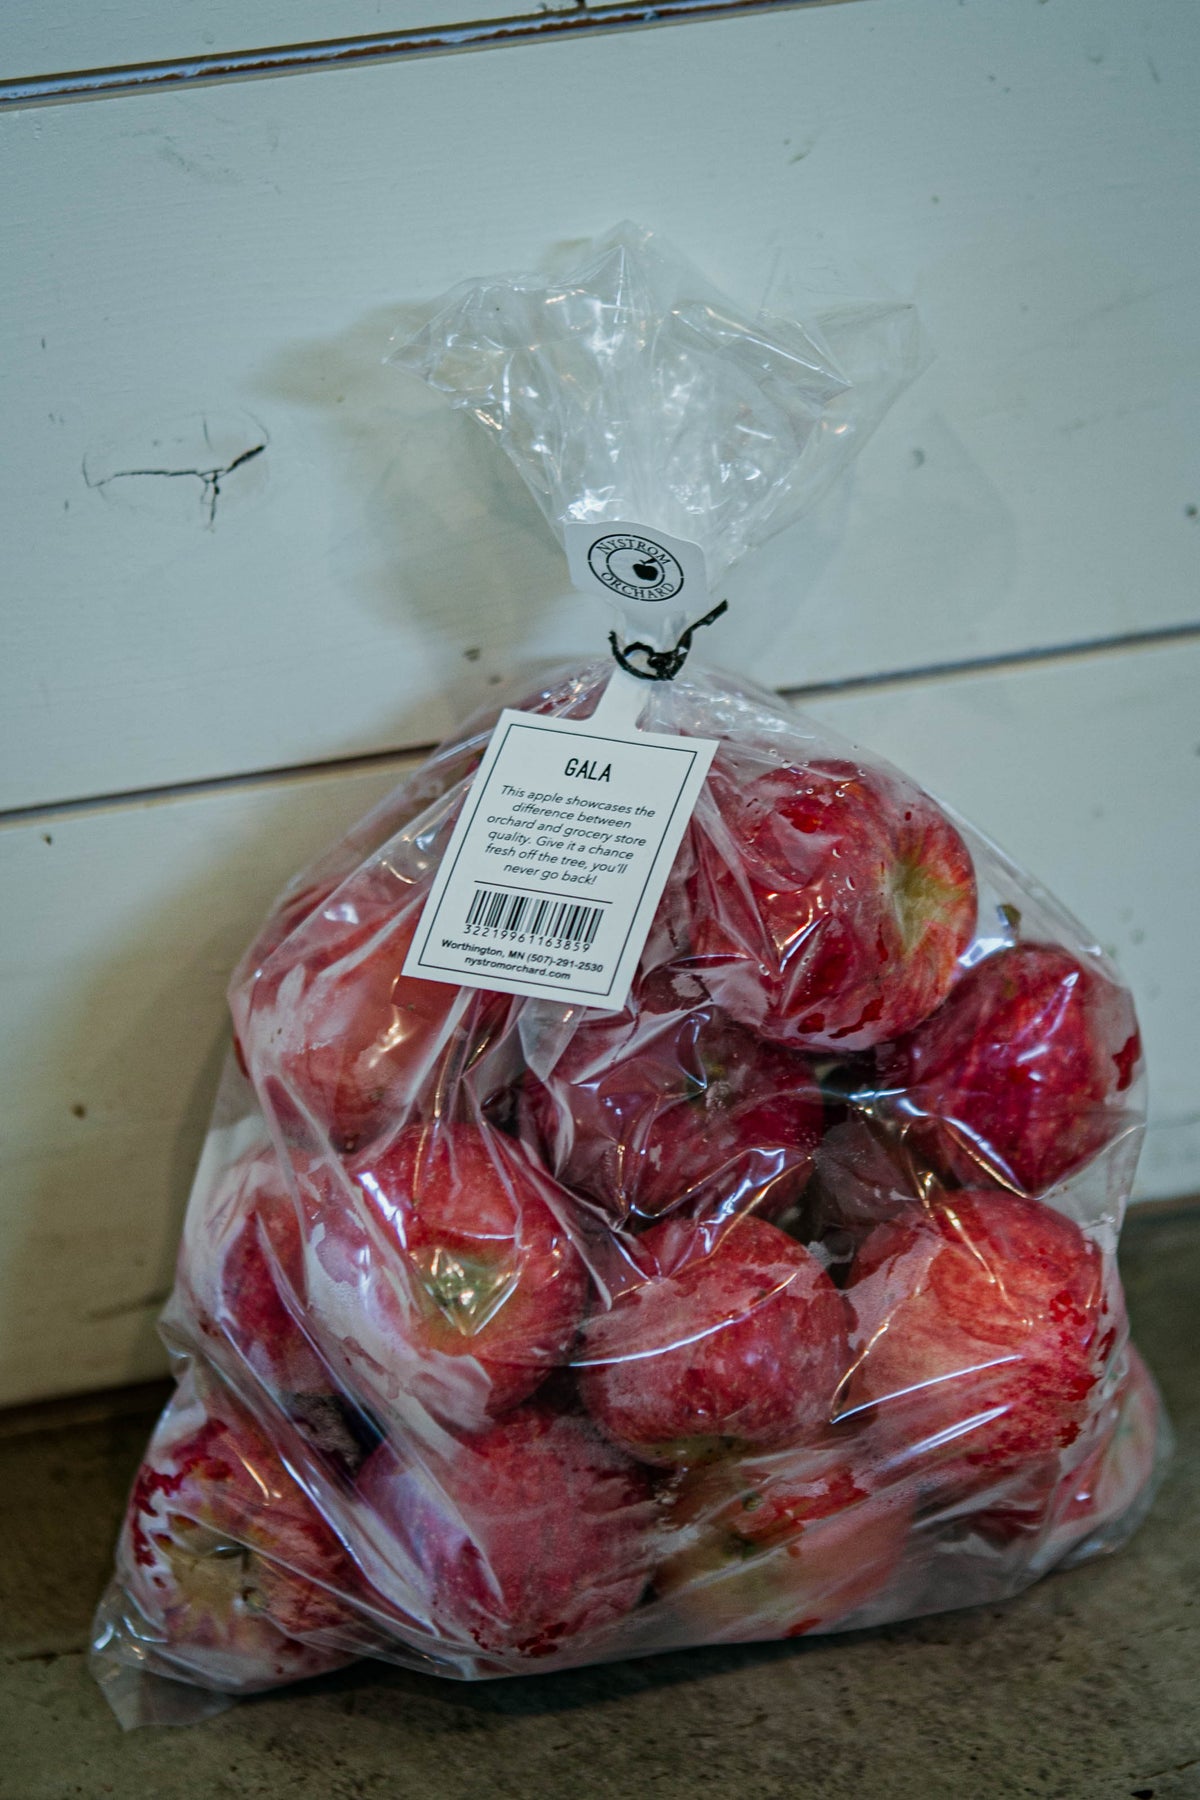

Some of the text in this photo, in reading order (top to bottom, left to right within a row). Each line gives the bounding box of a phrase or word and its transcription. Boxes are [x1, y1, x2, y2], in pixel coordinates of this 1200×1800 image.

[596, 539, 671, 564] NYSTROM
[601, 572, 674, 598] ORCHARD
[564, 758, 612, 782] GALA
[500, 785, 655, 817] This apple showcases the
[512, 803, 631, 828] difference between
[487, 815, 646, 846] orchard and grocery store
[488, 830, 532, 845] quality.
[536, 836, 564, 850] Give
[567, 841, 575, 851] it
[589, 846, 634, 859] chance
[485, 844, 627, 874] fresh off the tree, you'll
[504, 863, 598, 884] never go back!
[442, 939, 603, 972] Worthington, MN (507)-291-2530
[465, 956, 570, 980] nystromorchard.com
